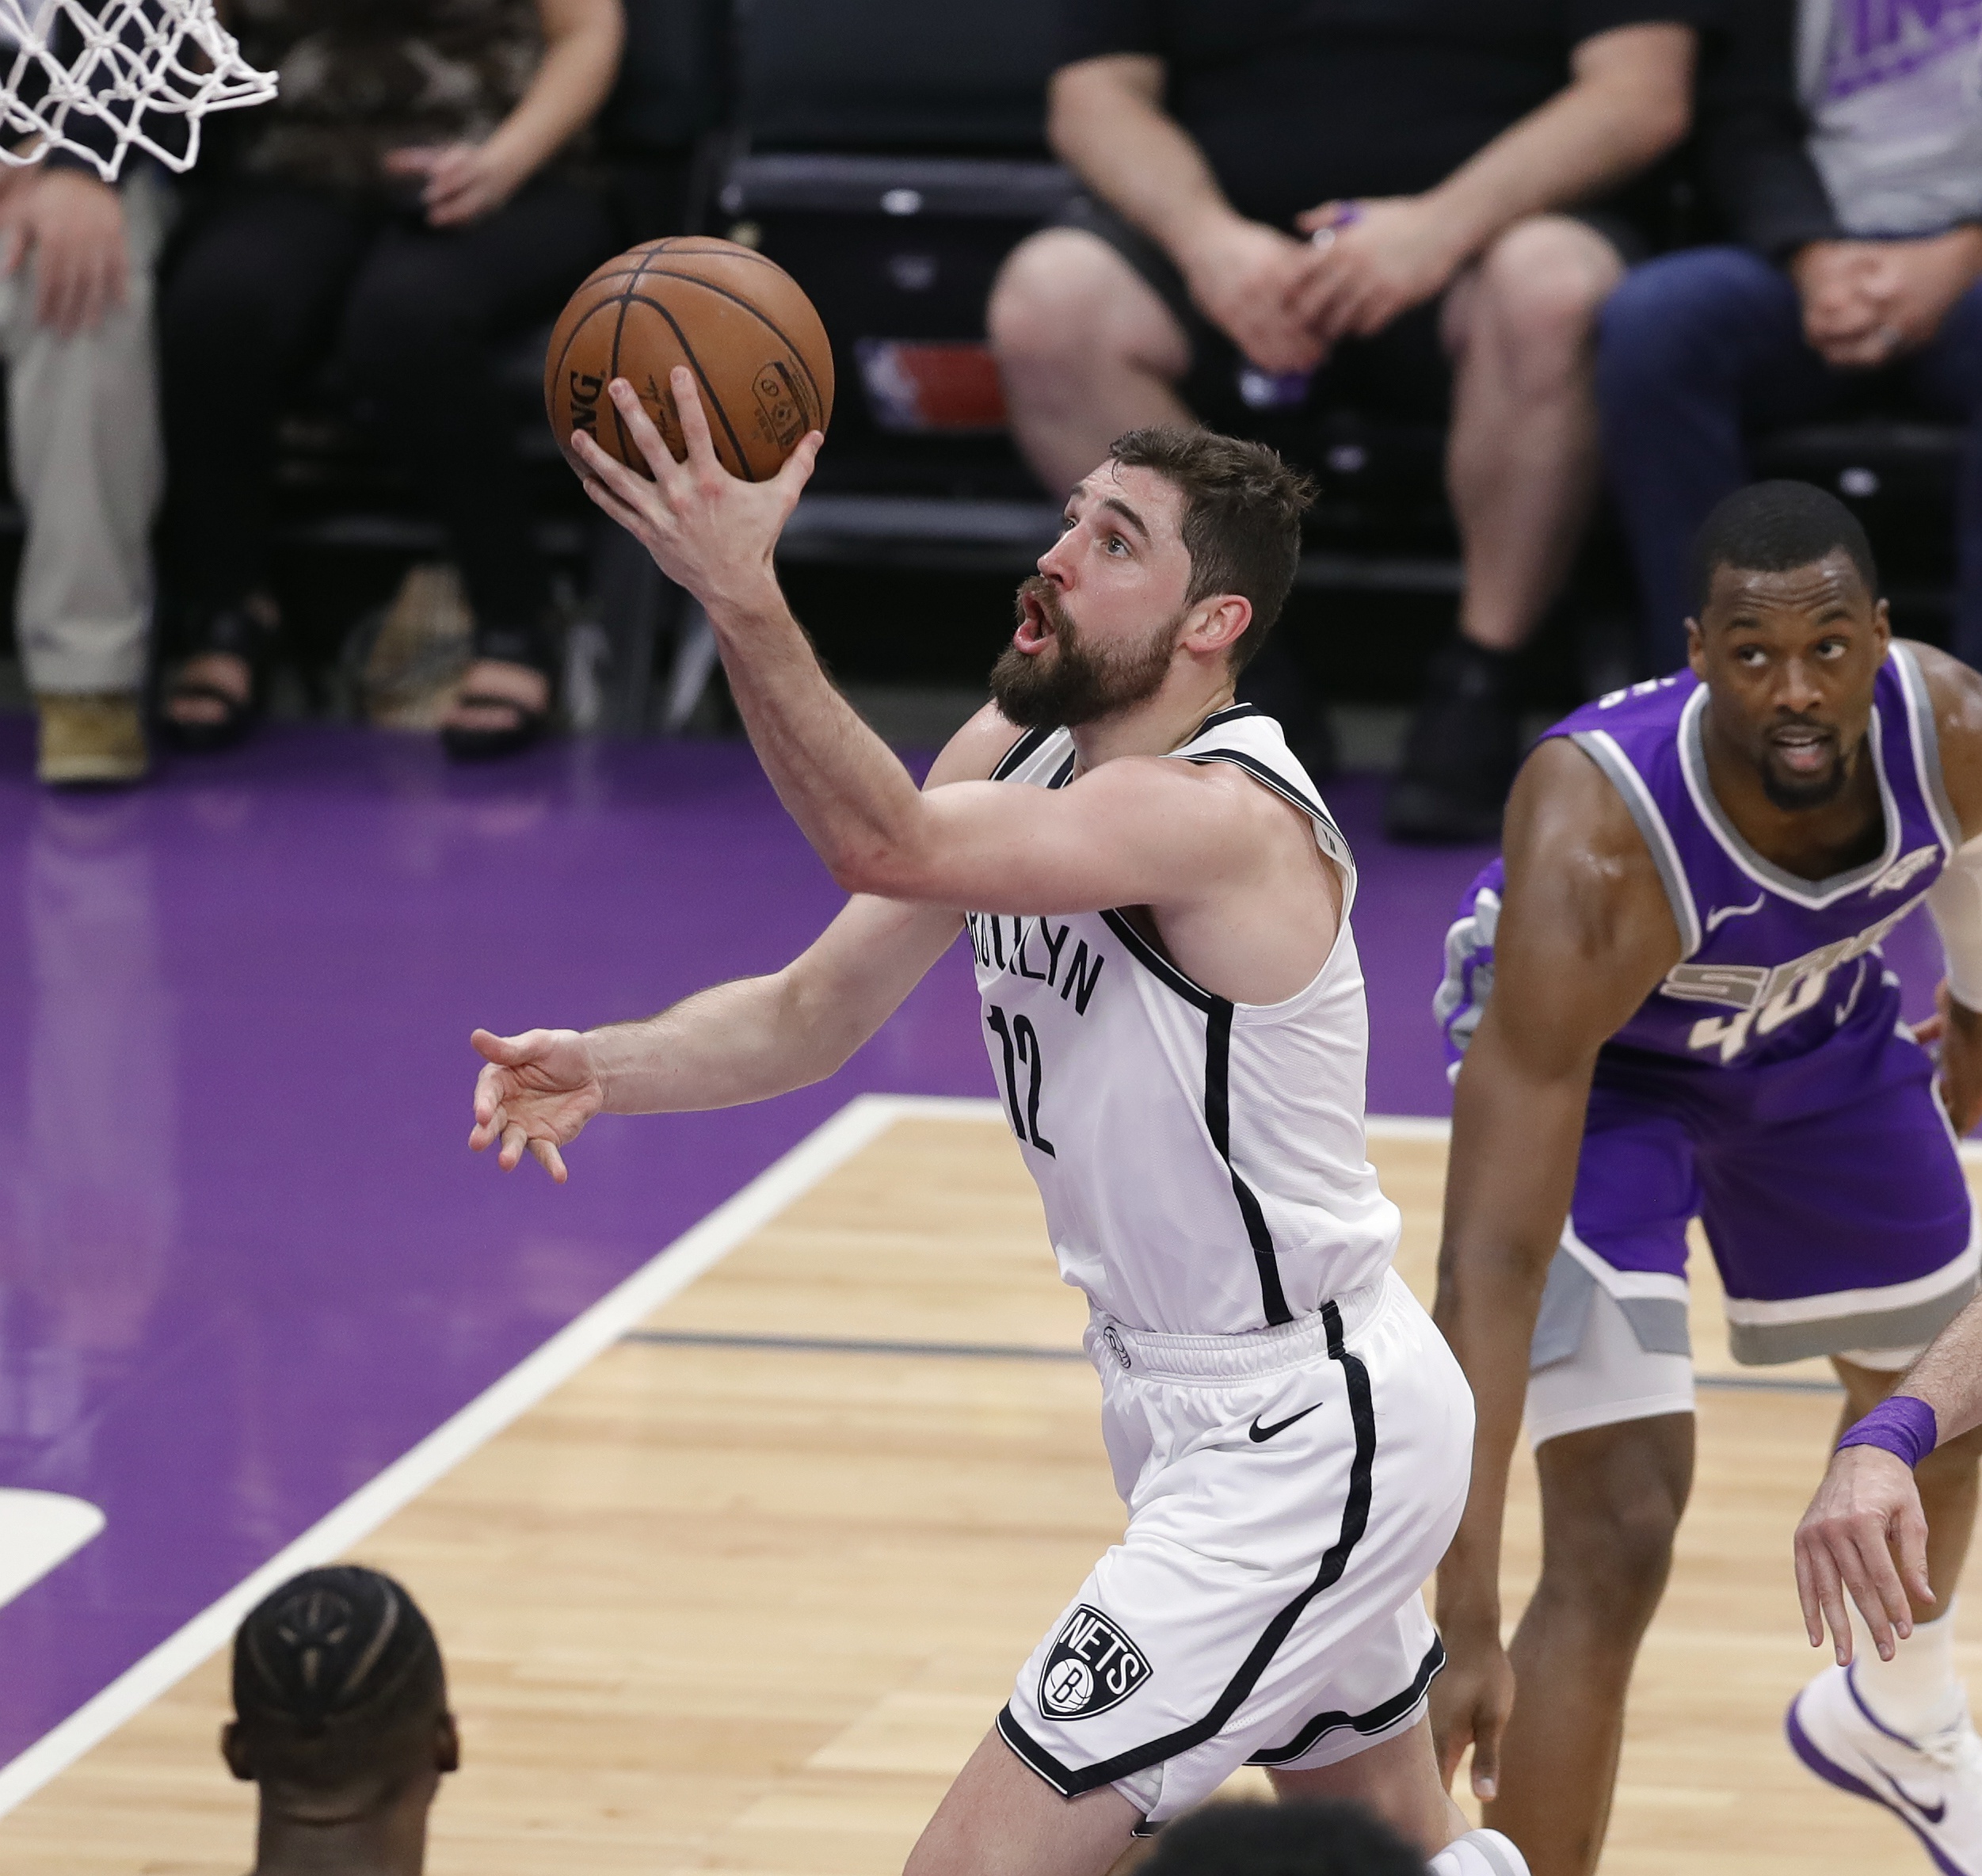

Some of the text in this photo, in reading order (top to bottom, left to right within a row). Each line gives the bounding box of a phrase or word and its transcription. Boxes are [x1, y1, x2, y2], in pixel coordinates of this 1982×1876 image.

[570, 370, 603, 442] NG
[1687, 968, 1828, 1064] 40
[986, 1004, 1057, 1161] 12
[1051, 1666, 1084, 1703] B
[1058, 1611, 1140, 1695] NETS
